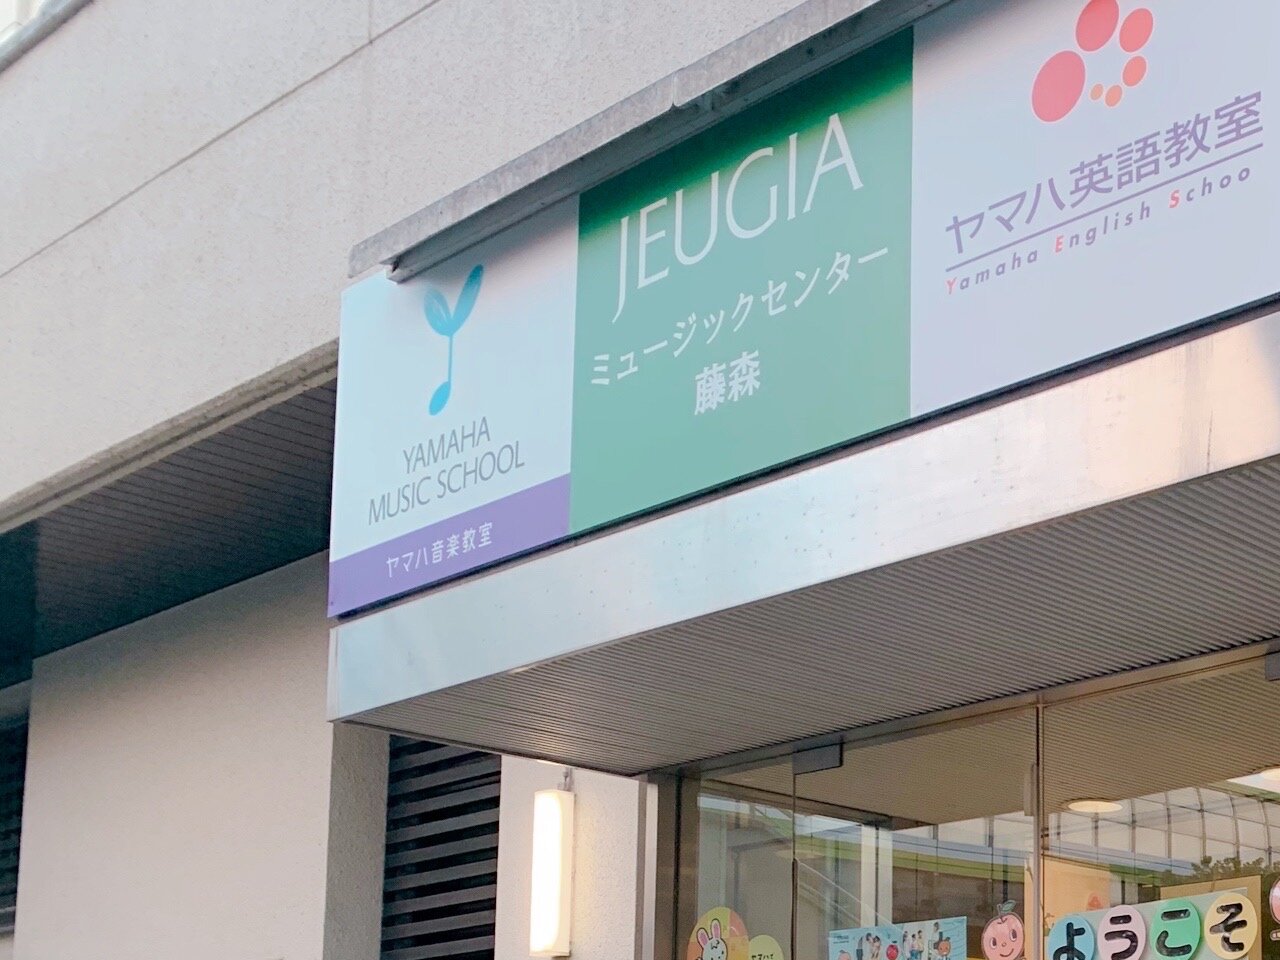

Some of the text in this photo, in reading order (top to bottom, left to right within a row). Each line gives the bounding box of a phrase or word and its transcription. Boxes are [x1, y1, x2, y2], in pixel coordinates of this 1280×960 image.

[945, 91, 1263, 254] ヤマハ英語教室
[612, 112, 864, 324] JEUGIA
[946, 250, 1038, 295] Yamaha
[1054, 202, 1150, 253] English
[591, 247, 888, 385] ミュージックセンター
[694, 350, 760, 415] 藤森
[368, 440, 525, 525] MUSIC SCHOOL
[403, 416, 491, 474] YAMAHA
[386, 522, 493, 578] ヤマハ音楽教室
